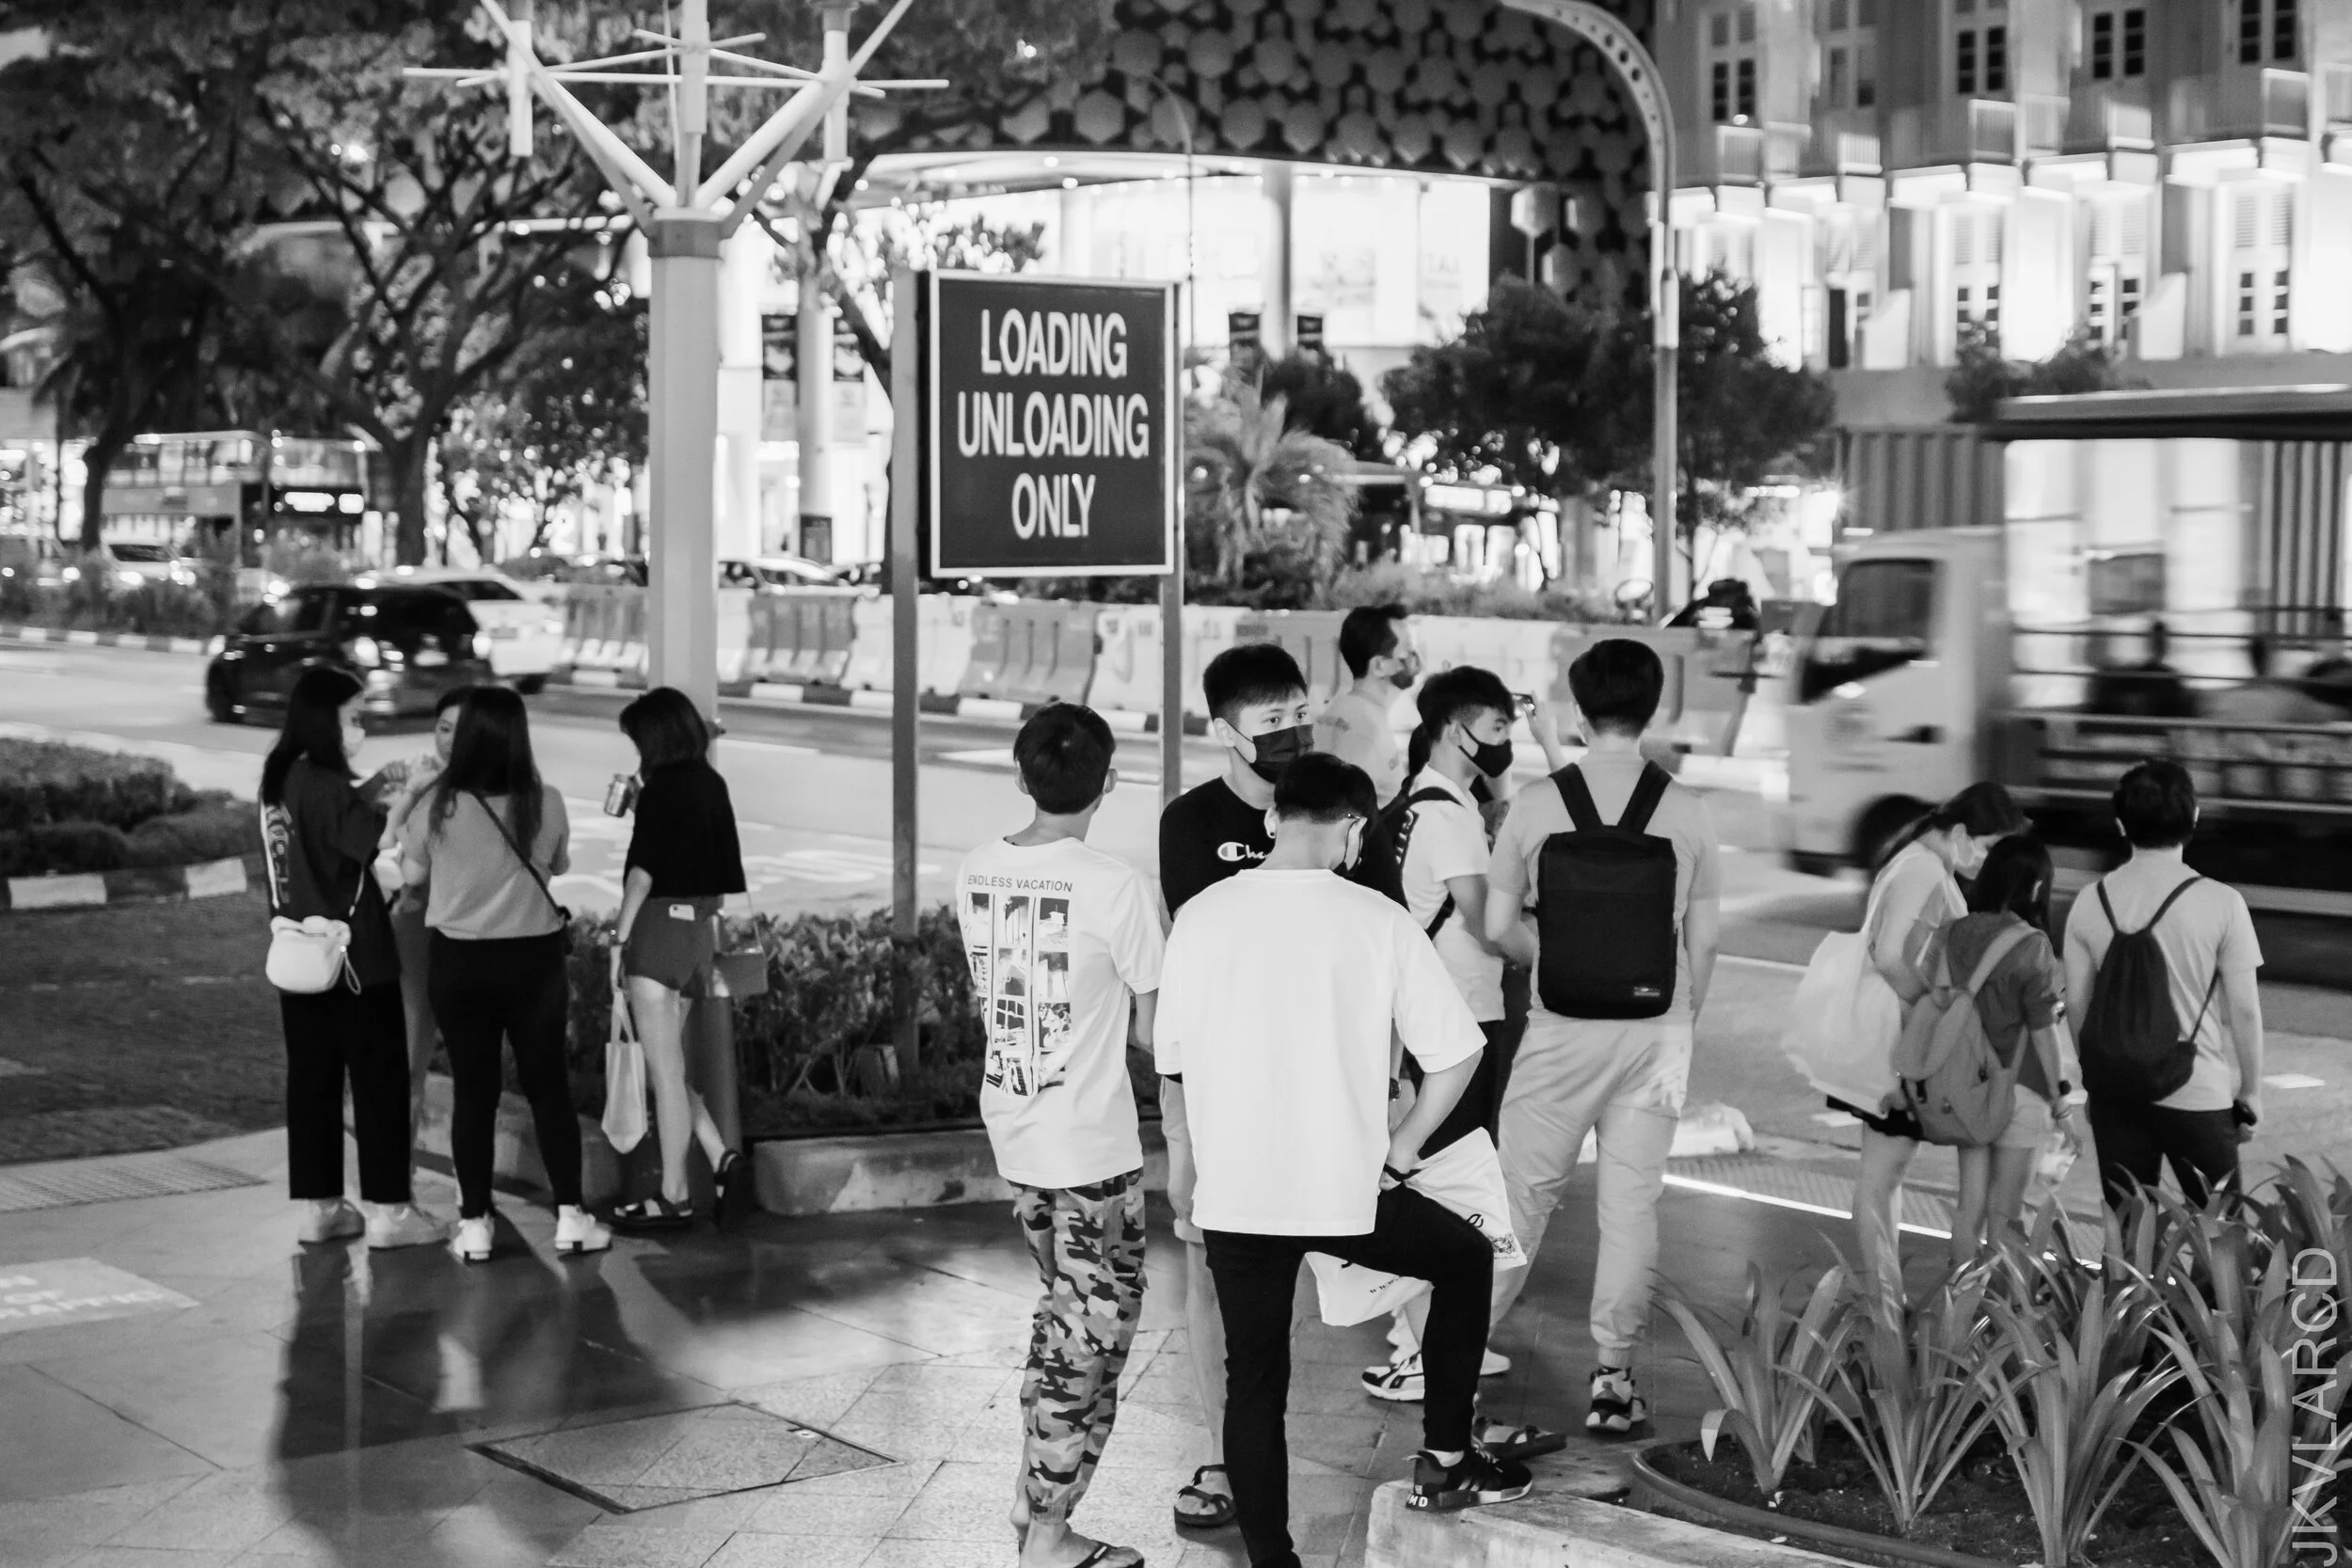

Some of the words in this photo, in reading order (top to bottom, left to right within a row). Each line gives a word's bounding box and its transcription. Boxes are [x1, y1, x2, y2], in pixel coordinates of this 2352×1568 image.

[981, 308, 1128, 379] LOADING
[958, 390, 1150, 459] UNLOADING
[1011, 472, 1096, 540] ONLY
[967, 874, 1013, 889] ENDLESS
[1016, 878, 1073, 893] VACATION
